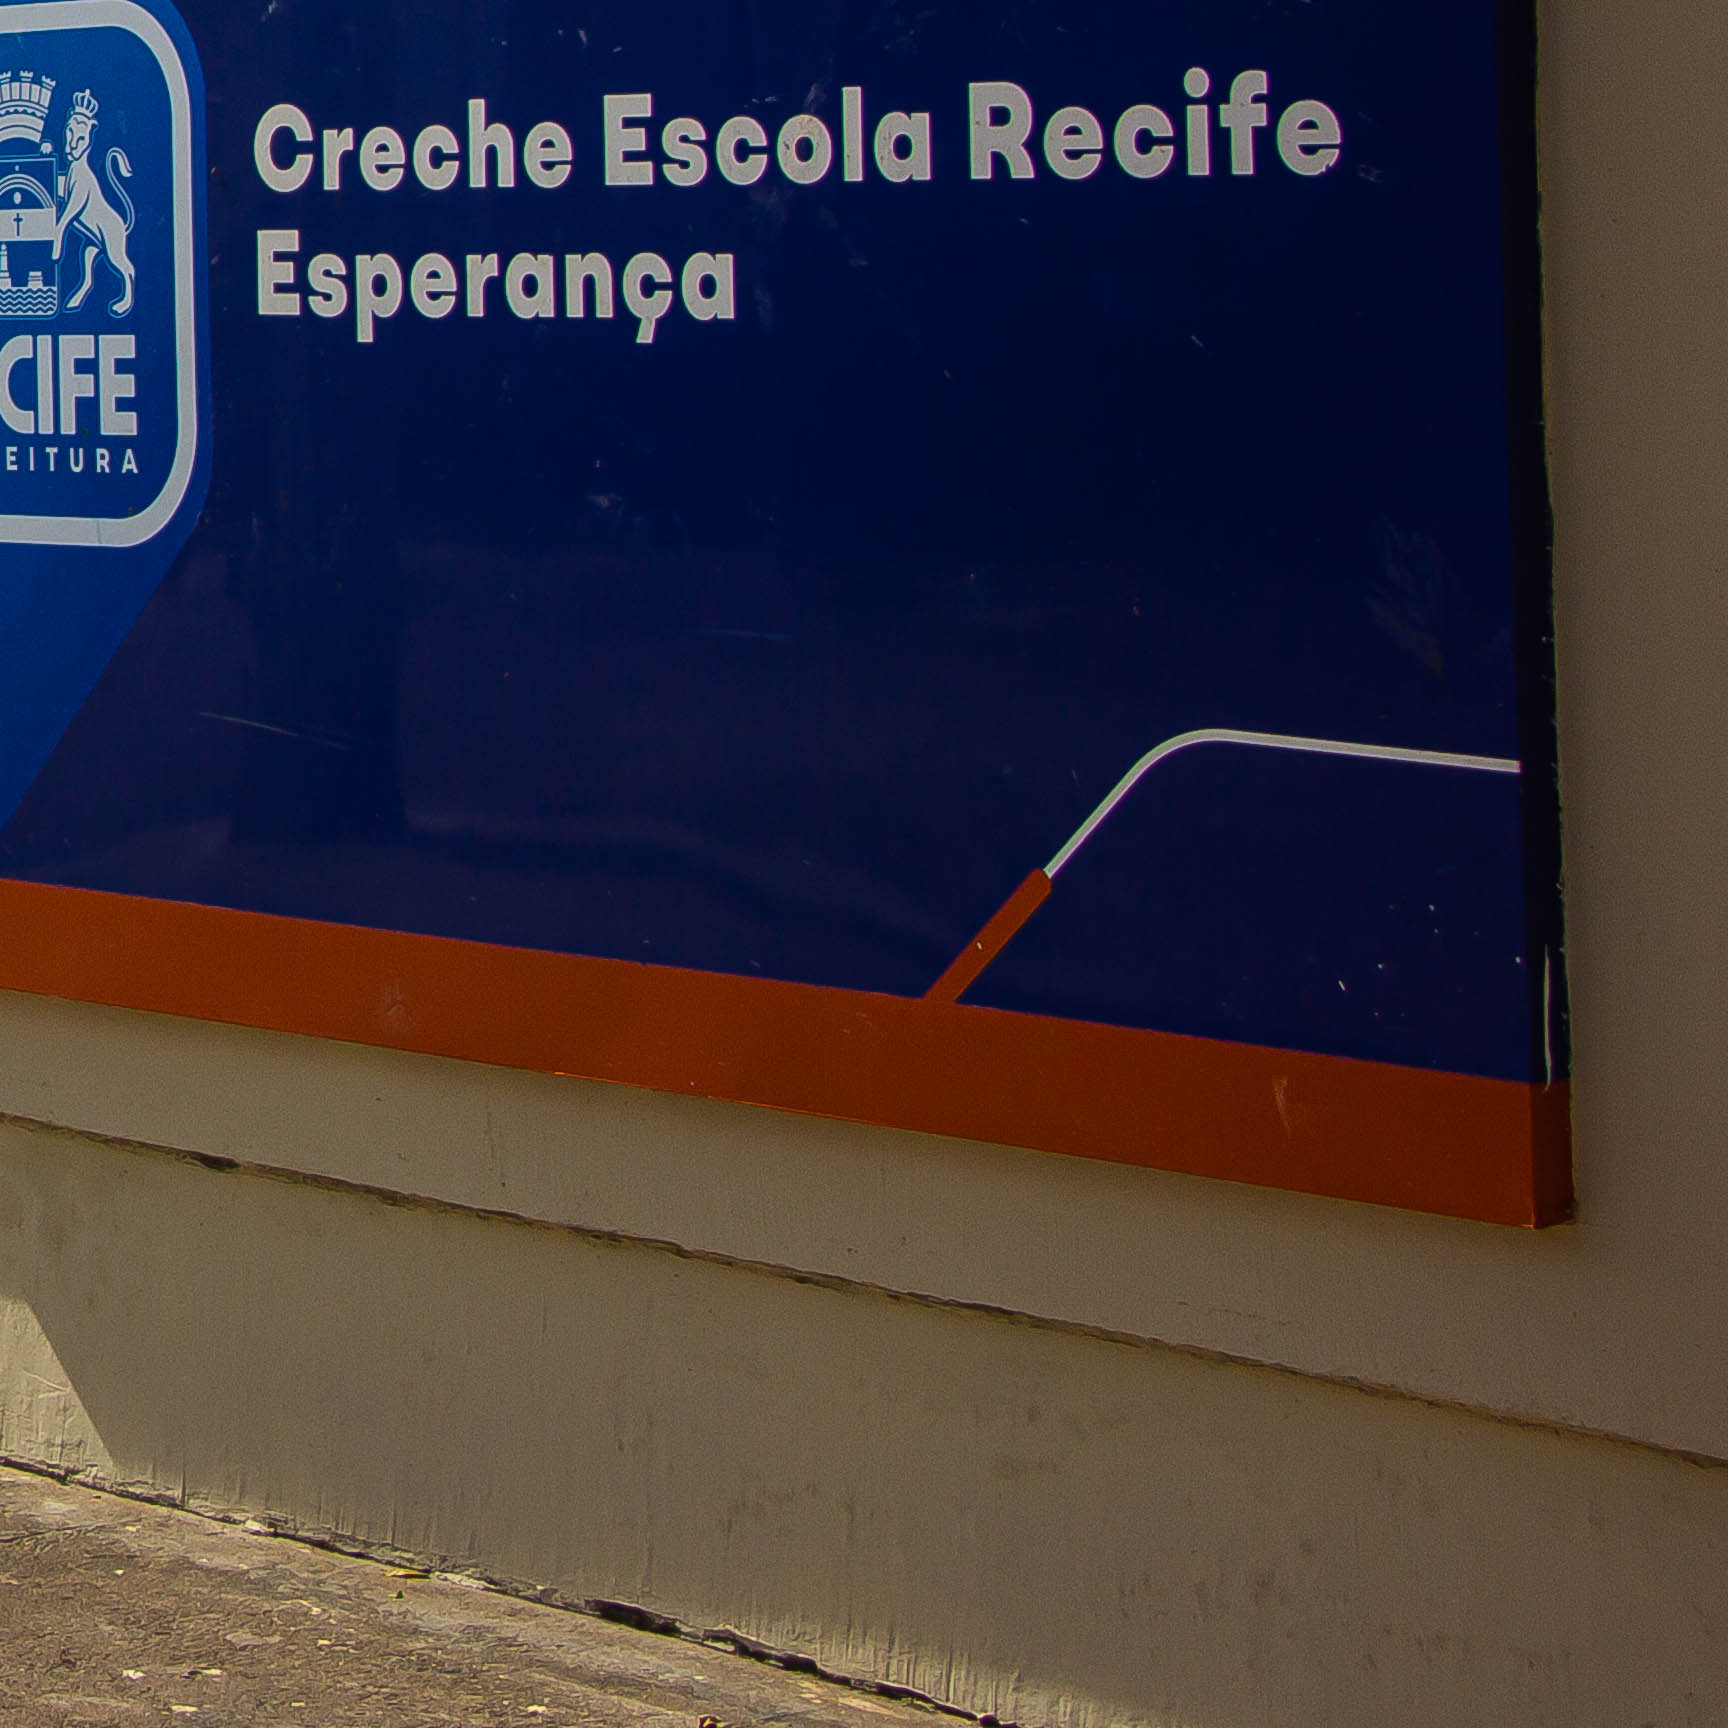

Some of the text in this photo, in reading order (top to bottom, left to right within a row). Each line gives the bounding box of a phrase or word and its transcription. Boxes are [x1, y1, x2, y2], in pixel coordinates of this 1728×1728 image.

[254, 67, 1342, 192] Creche Escola Recife
[256, 229, 736, 344] Esperança
